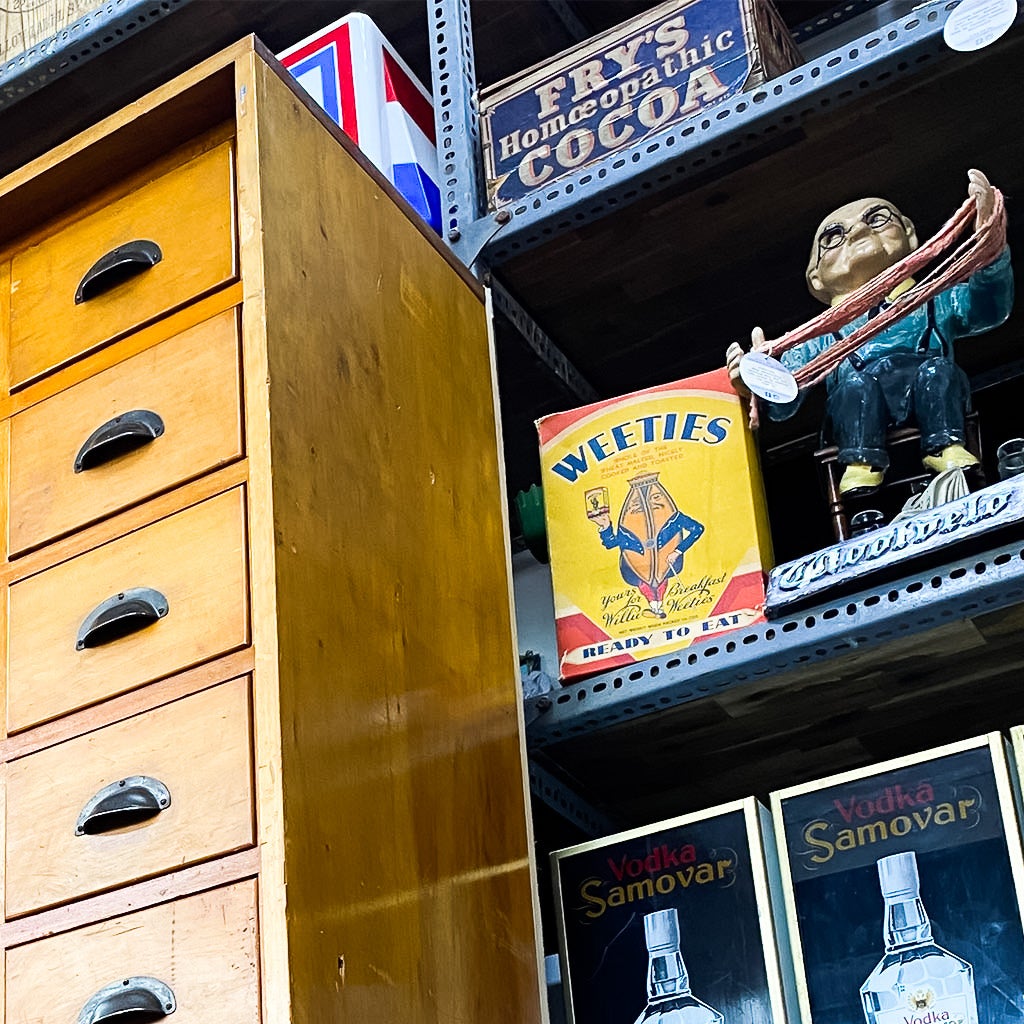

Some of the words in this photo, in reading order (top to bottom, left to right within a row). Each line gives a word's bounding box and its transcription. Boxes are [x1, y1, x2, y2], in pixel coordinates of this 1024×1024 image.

[534, 15, 689, 119] FRY'S
[518, 65, 728, 186] COCOA
[551, 413, 731, 484] WEETIES
[632, 463, 648, 471] AND
[651, 453, 684, 465] TOASTED
[601, 588, 637, 611] Yours
[626, 595, 641, 607] for
[667, 572, 727, 597] Breakfast
[583, 633, 653, 659] READY
[663, 626, 691, 641] TO
[702, 613, 742, 632] EAT
[833, 781, 935, 824] Vodka
[804, 799, 975, 863] Samovar
[608, 844, 696, 881] Vodka
[580, 859, 732, 918] Samovar
